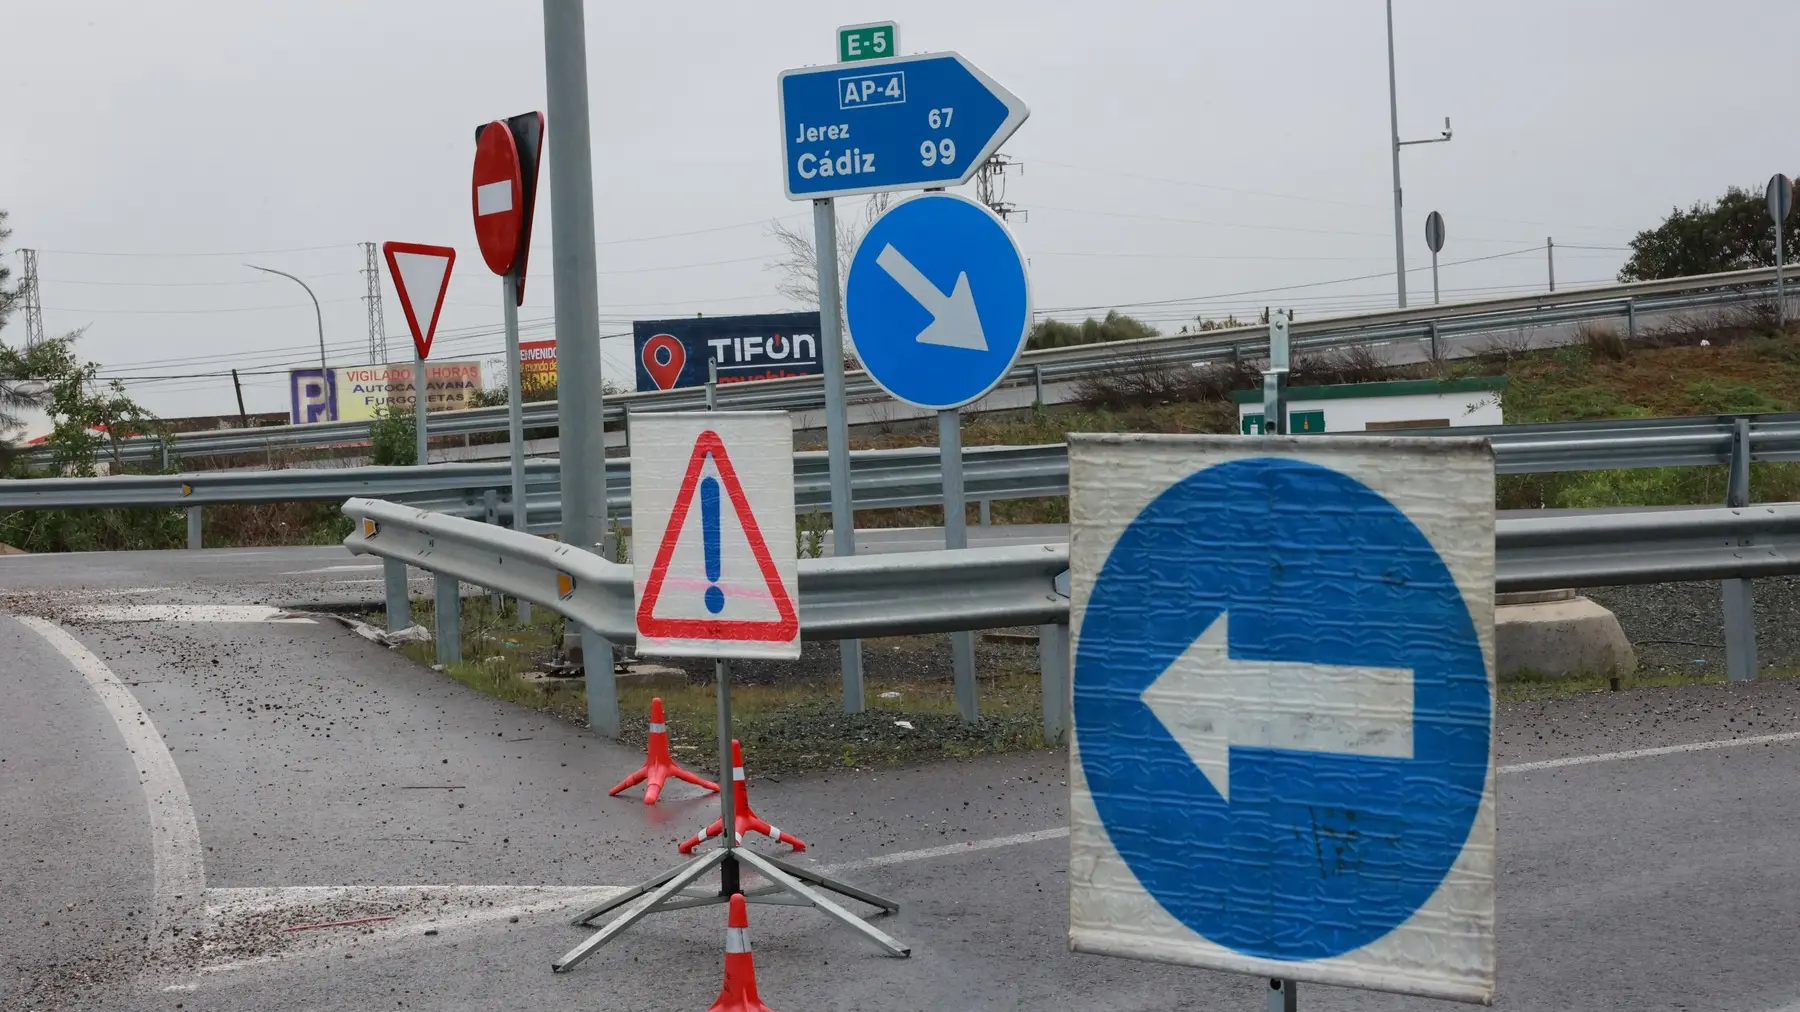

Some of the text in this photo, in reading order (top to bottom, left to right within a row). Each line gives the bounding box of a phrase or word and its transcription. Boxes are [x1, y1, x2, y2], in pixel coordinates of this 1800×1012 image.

[847, 31, 887, 56] E-5
[844, 77, 901, 104] AP-4
[796, 107, 954, 143] Jerez 67
[797, 138, 956, 179] Cádiz 99
[346, 368, 411, 383] VIGILADO
[432, 366, 478, 379] HORAS
[352, 380, 475, 394] AUTOCAAVANA
[365, 393, 464, 406] FURGOETAS
